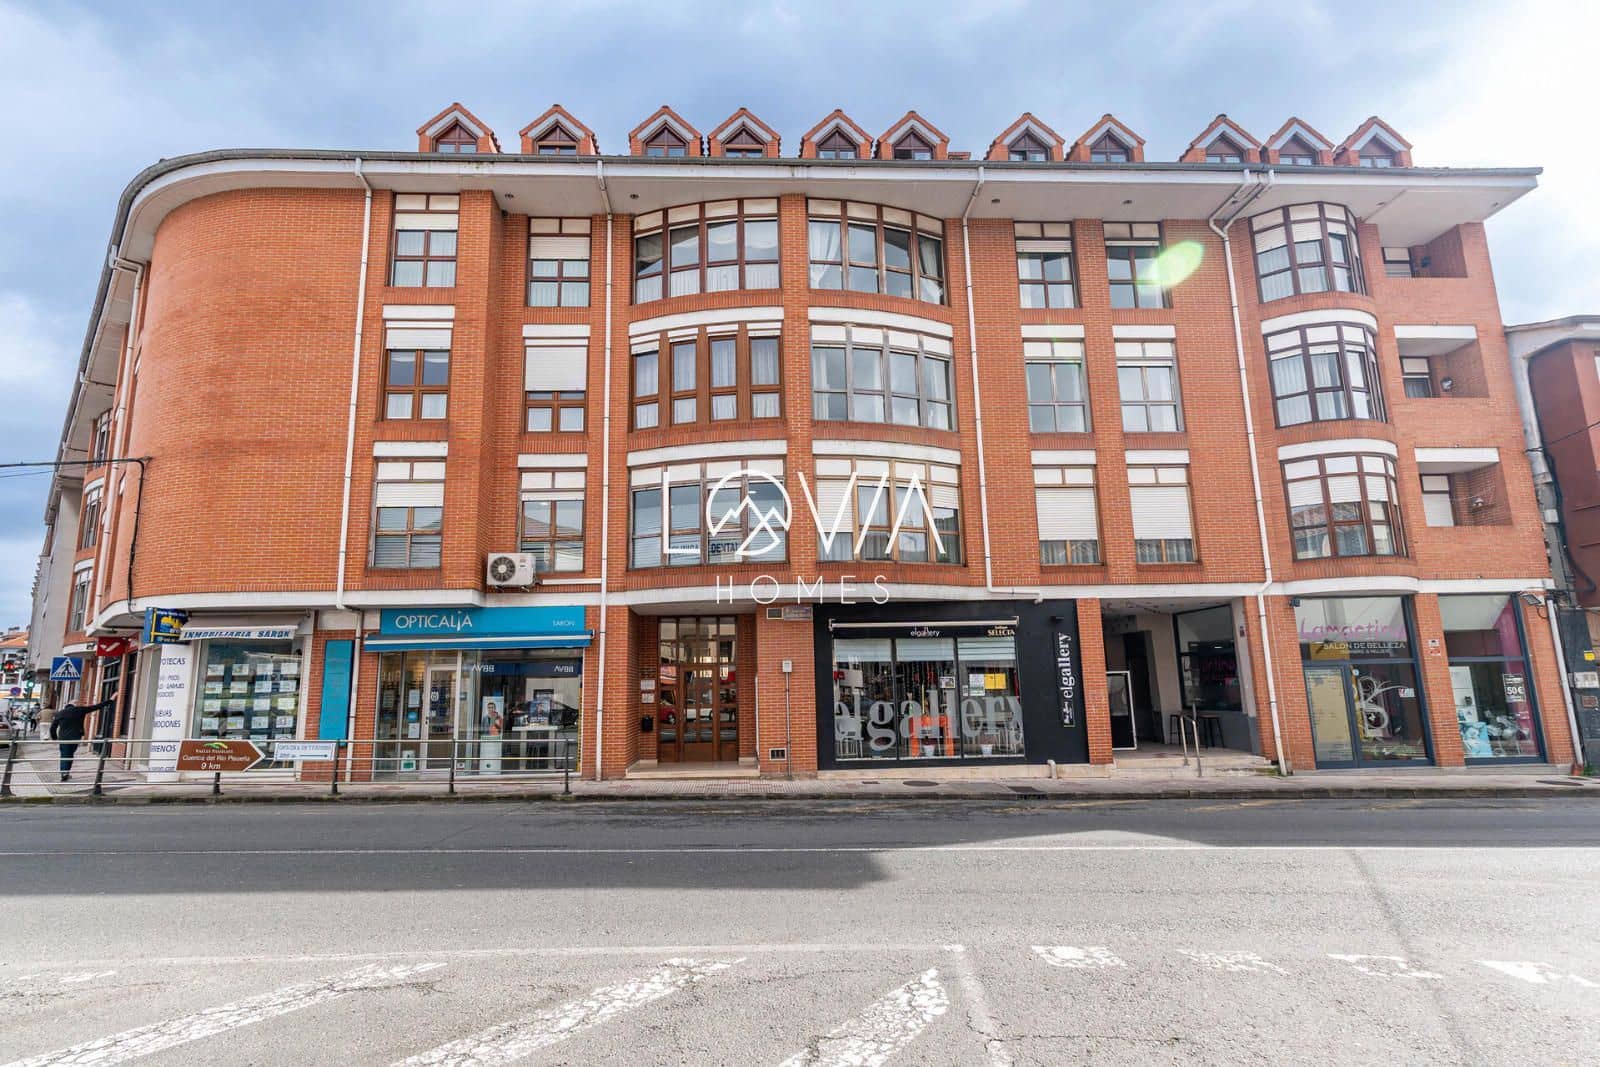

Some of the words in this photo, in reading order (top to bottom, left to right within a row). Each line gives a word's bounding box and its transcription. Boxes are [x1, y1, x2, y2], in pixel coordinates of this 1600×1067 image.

[183, 631, 251, 639] INMOBILIARIA
[1058, 632, 1076, 699] elgallery
[201, 762, 207, 770] 9
[208, 761, 221, 769] km
